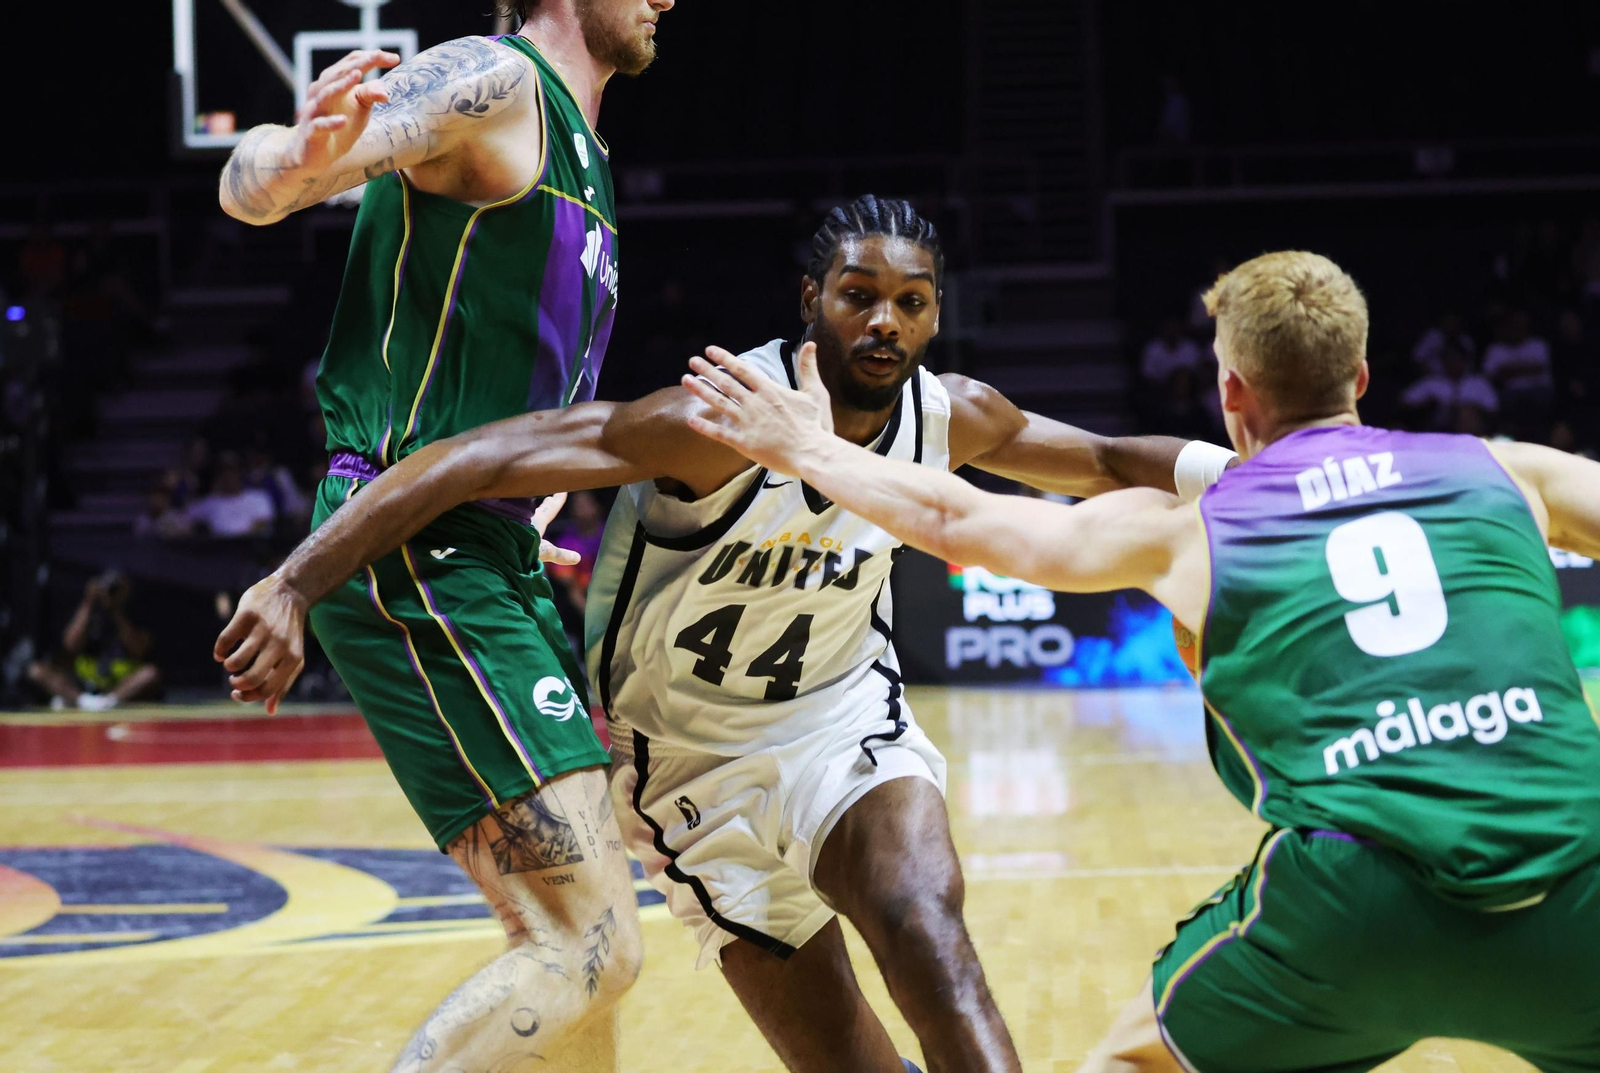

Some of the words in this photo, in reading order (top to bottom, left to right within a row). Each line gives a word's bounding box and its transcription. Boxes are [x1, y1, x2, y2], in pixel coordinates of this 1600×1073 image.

[1295, 452, 1402, 511] DÍAZ
[1325, 511, 1449, 657] 9
[674, 604, 815, 700] 44
[945, 625, 1075, 669] PRO
[543, 874, 575, 886] VENI
